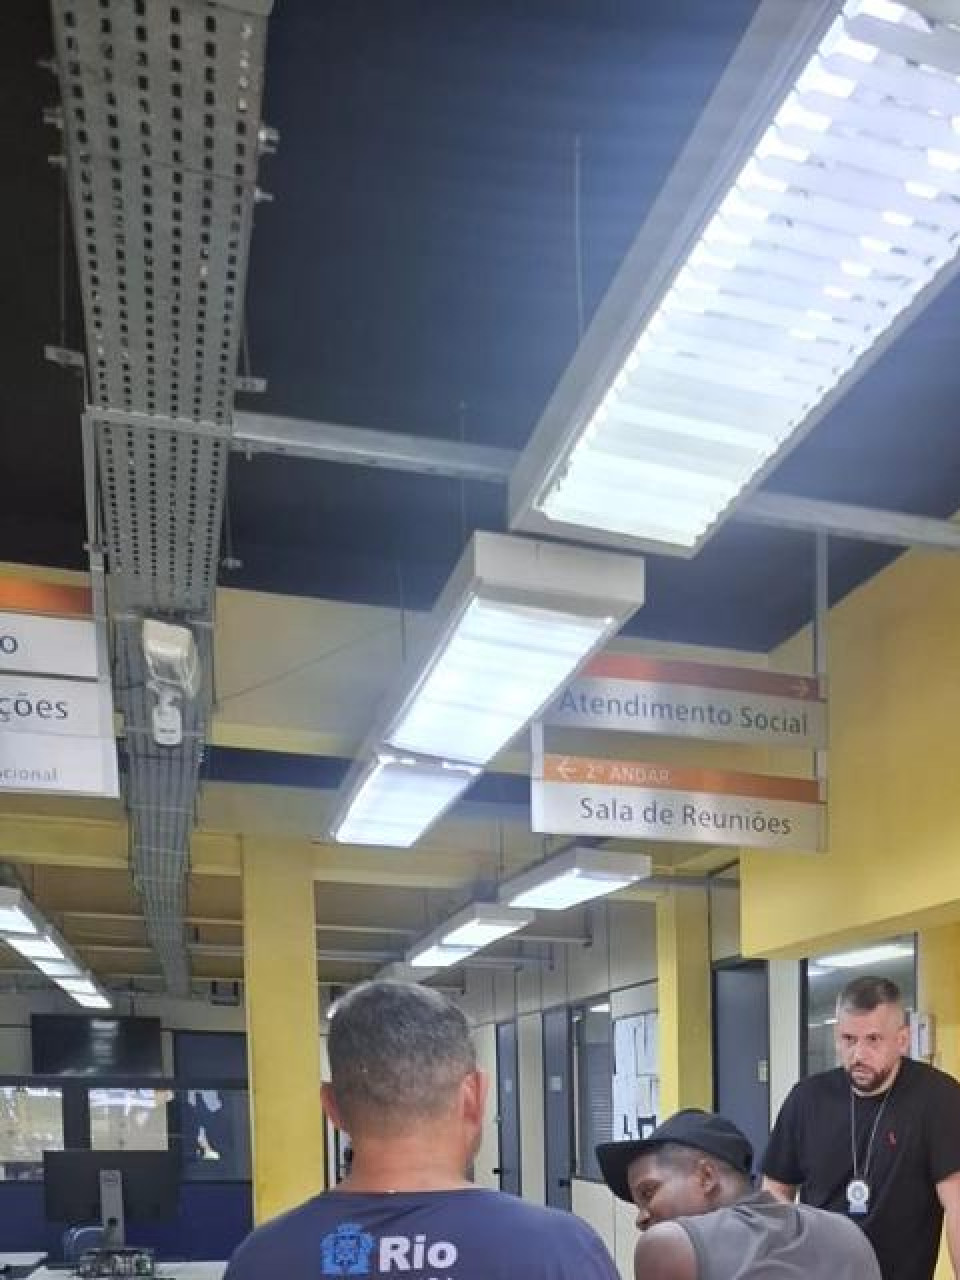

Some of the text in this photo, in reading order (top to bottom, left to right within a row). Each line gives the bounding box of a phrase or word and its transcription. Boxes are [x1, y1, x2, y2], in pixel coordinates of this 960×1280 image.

[558, 686, 808, 736] Atendimento Social
[608, 764, 670, 783] ANDAR
[580, 798, 792, 835] Sala de Reuniões
[379, 1233, 459, 1273] Rio
